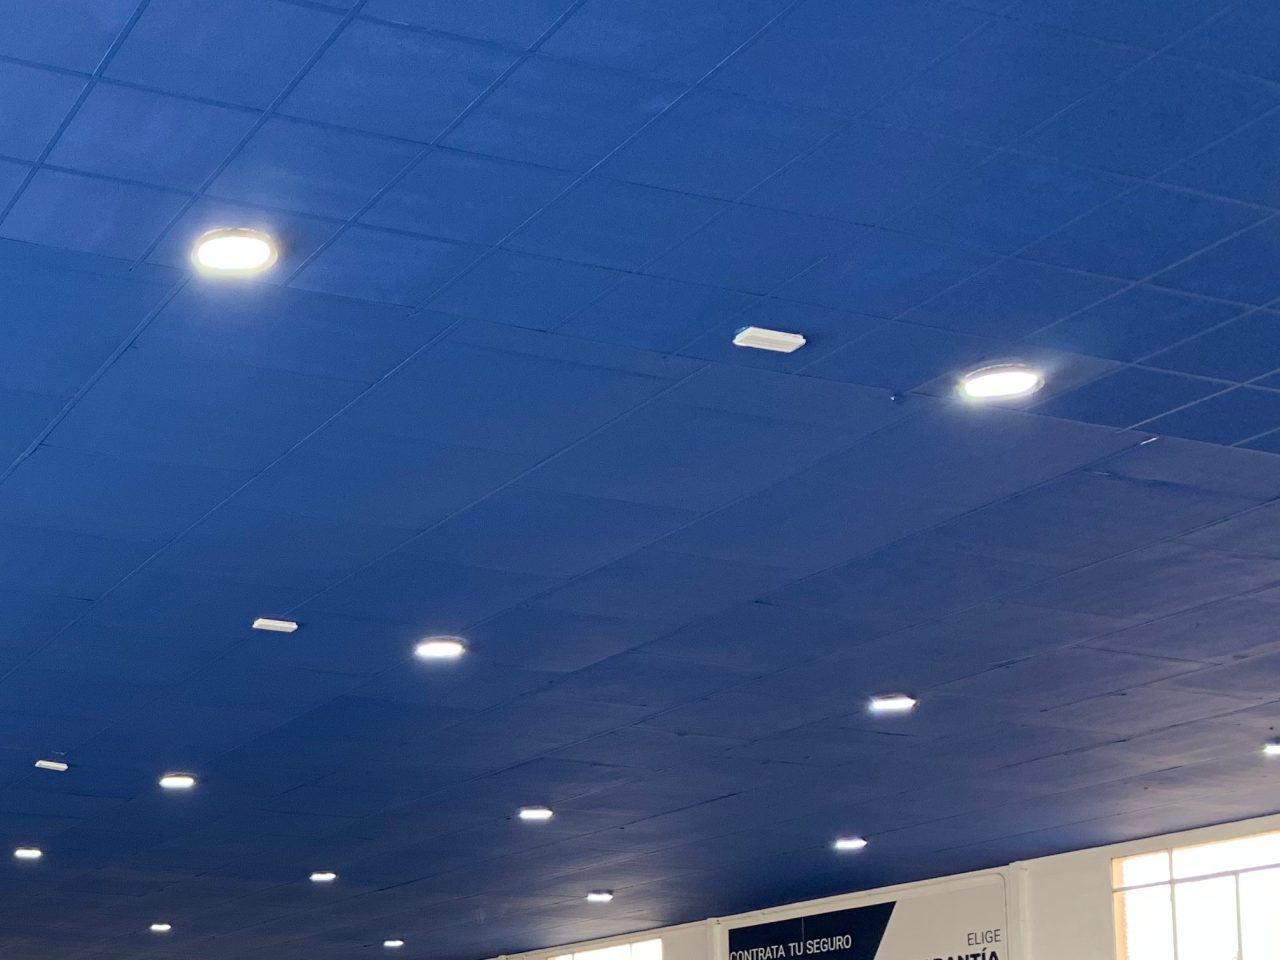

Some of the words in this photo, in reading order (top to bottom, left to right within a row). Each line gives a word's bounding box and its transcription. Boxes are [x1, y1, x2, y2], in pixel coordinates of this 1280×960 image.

[788, 942, 804, 956] TU
[806, 934, 852, 955] SEGURO
[967, 929, 1001, 947] ELIGE
